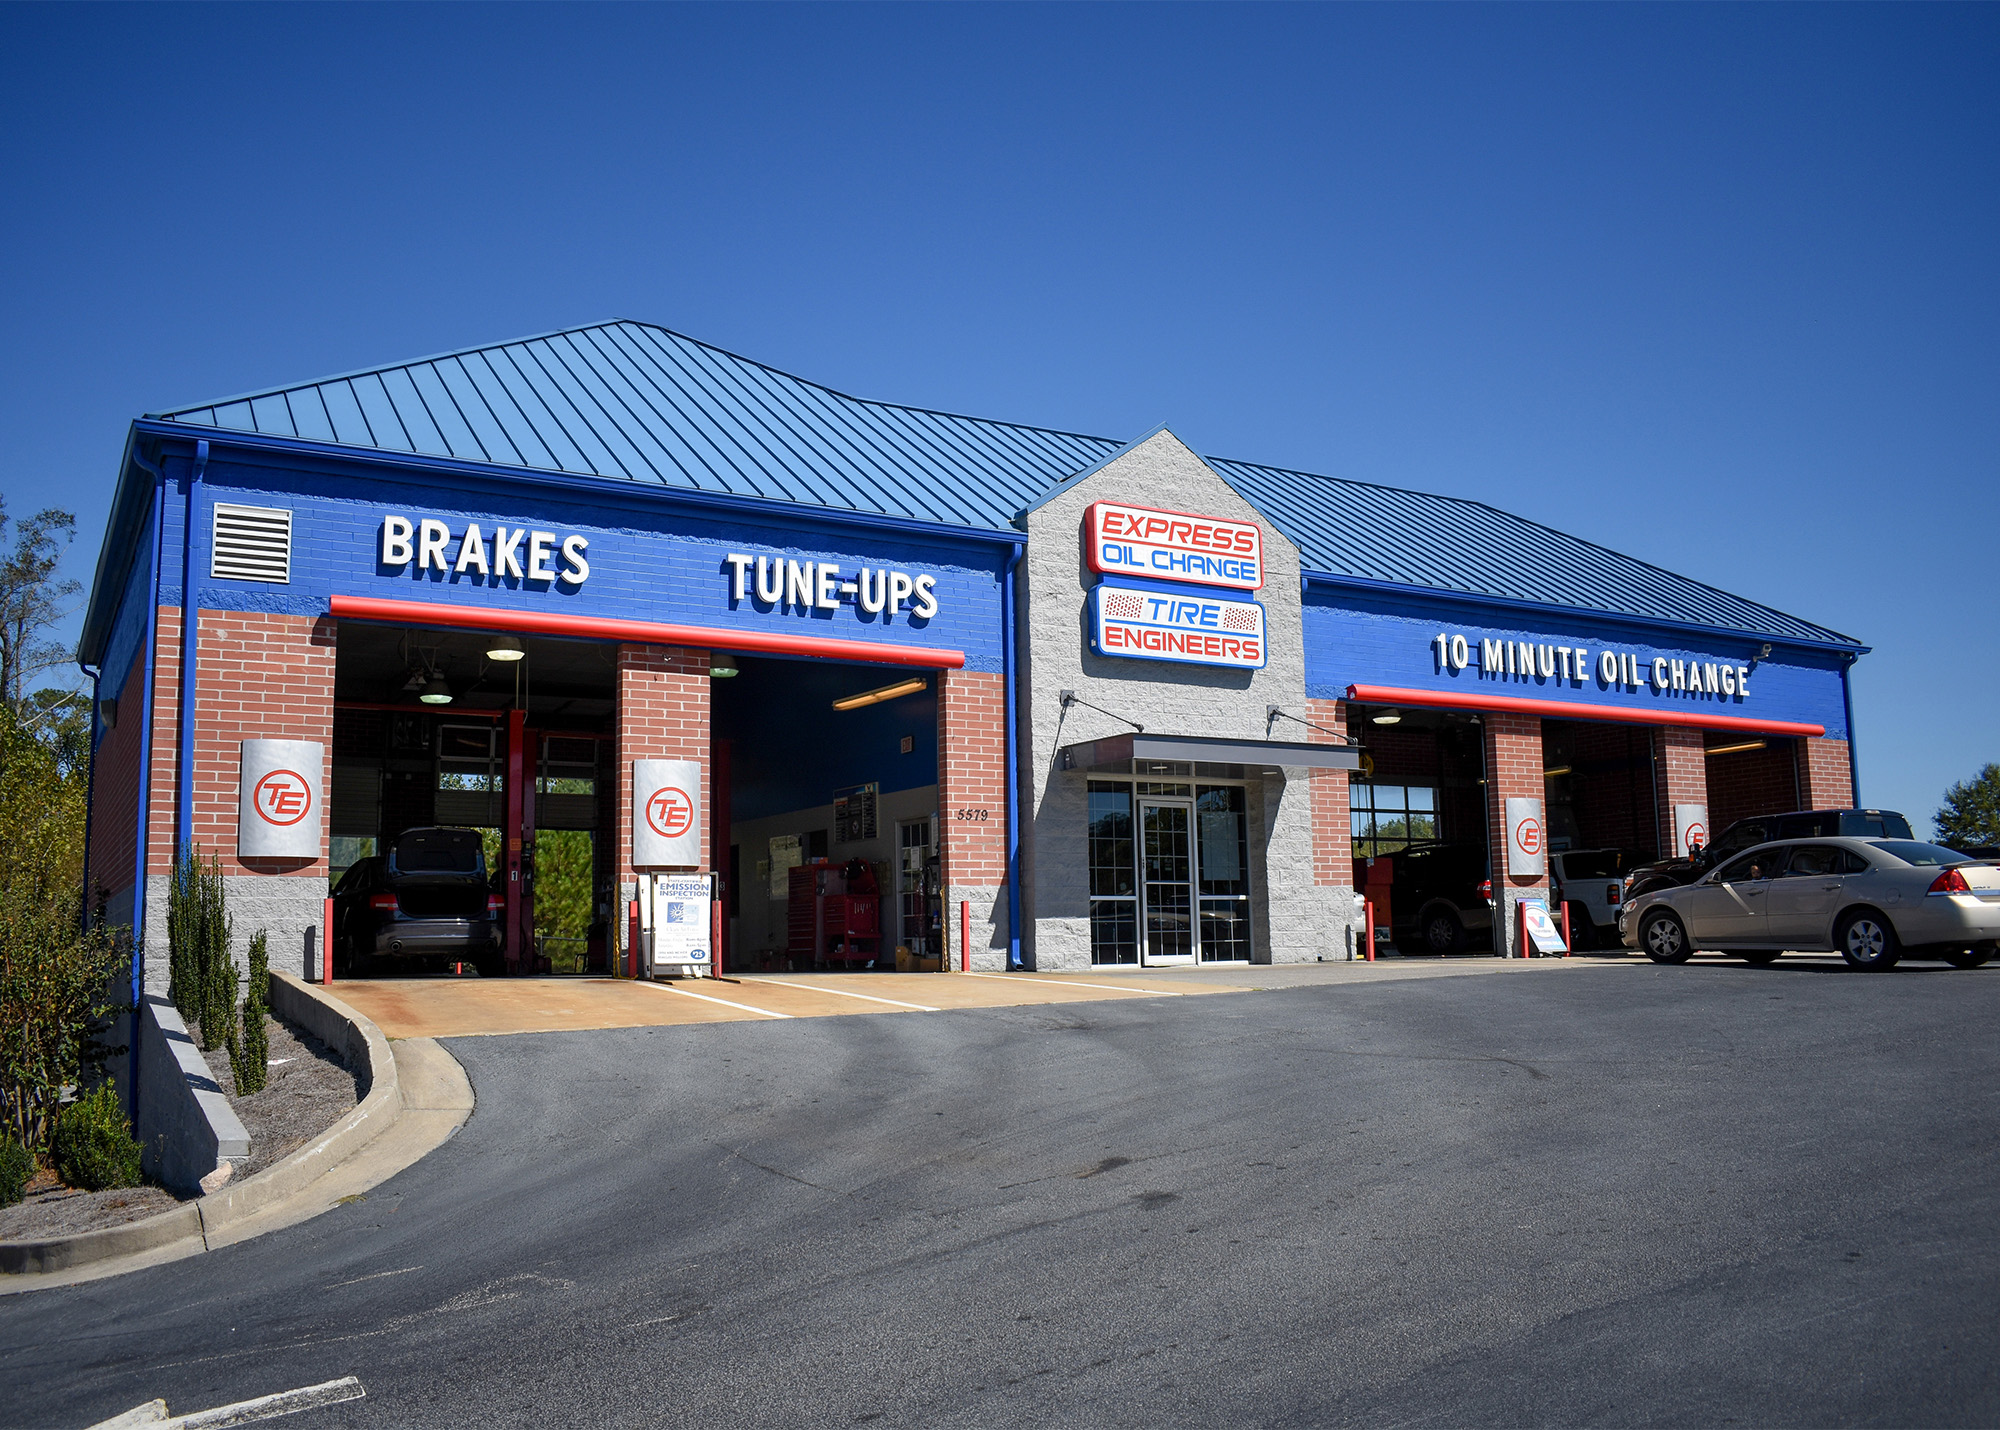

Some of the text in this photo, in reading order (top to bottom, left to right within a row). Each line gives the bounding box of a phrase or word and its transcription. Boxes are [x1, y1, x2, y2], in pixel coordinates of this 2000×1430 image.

[1102, 511, 1255, 552] EXPRESS
[382, 515, 590, 585] BRAKES
[1102, 543, 1256, 581] OIL CHANGE
[726, 553, 938, 619] TUNE-UPS
[1148, 598, 1221, 627] TIRE
[1105, 626, 1260, 660] ENGINEERS
[1436, 632, 1750, 697] 10 MINUTE OIL CHANGE
[263, 783, 305, 815] TE
[654, 799, 688, 828] TE
[957, 809, 988, 821] 5579
[660, 883, 709, 891] EMISSION
